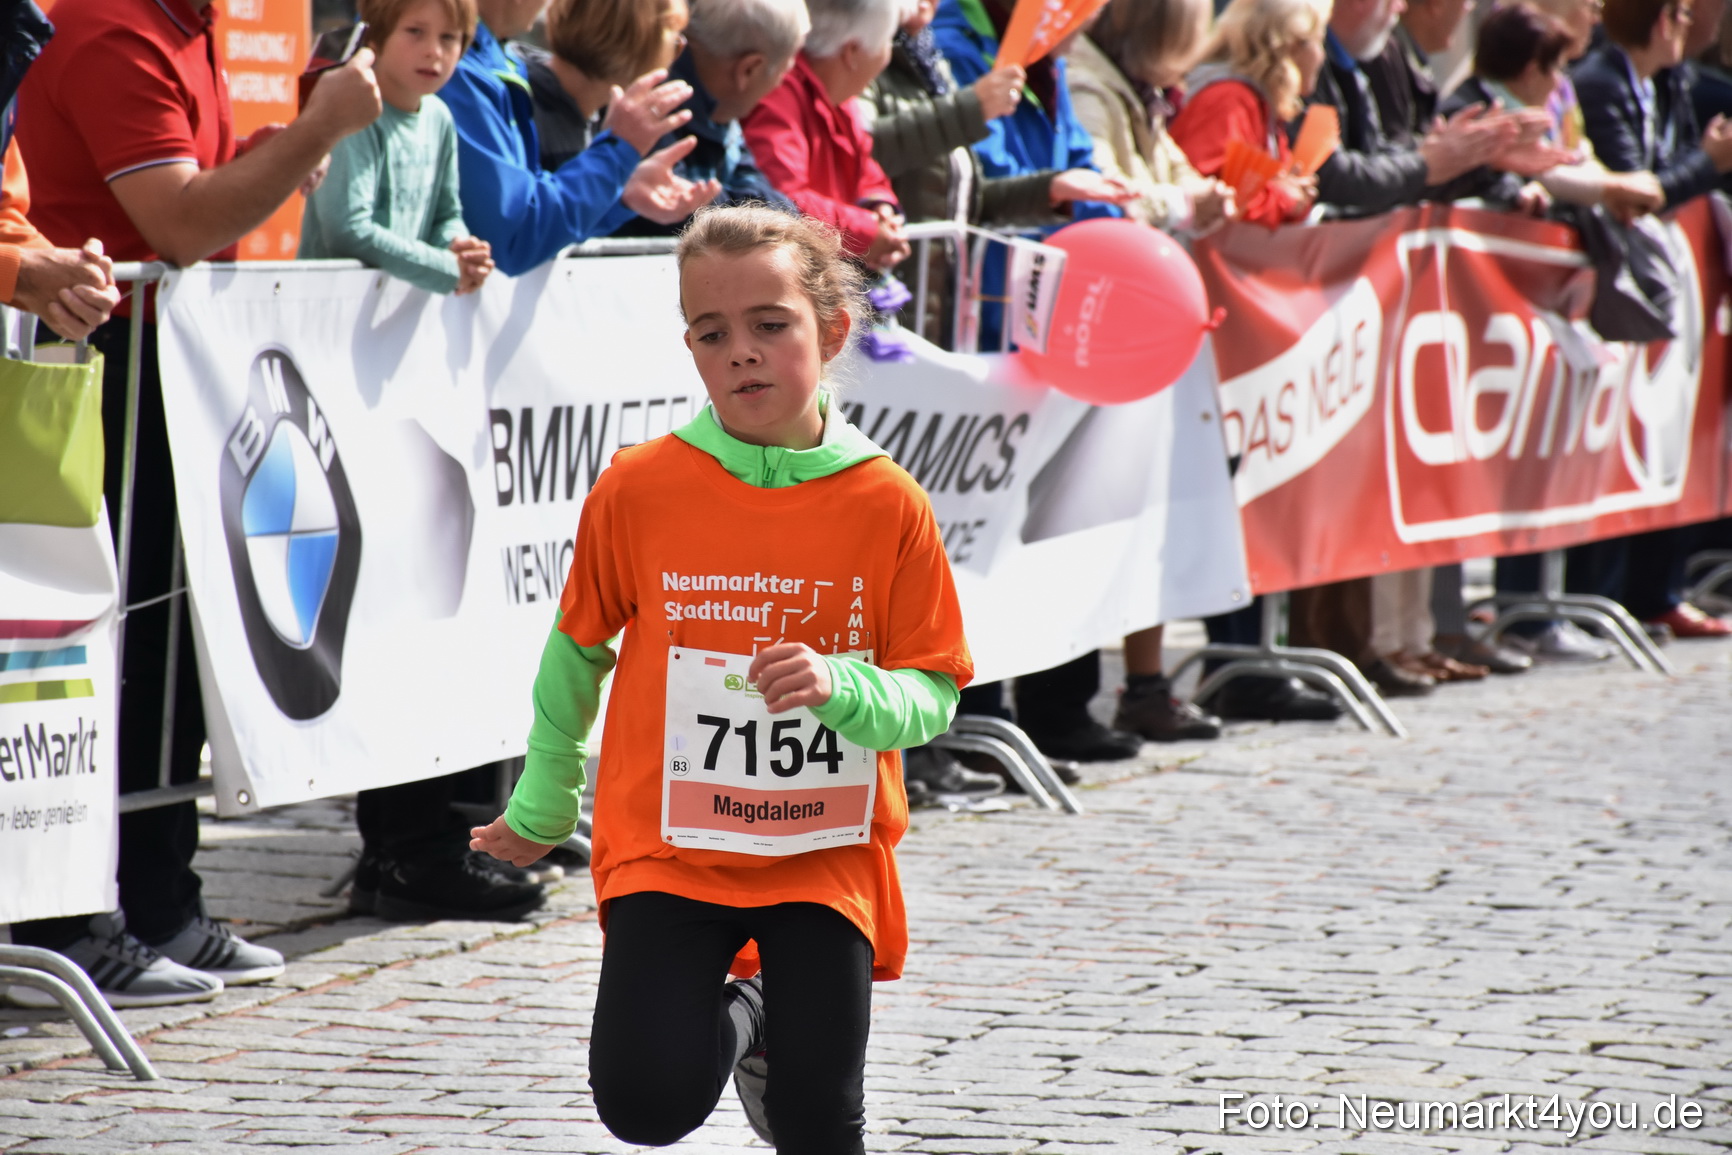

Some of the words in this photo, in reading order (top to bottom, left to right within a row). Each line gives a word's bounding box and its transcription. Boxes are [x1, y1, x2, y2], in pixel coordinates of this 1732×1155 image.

[1221, 381, 1297, 474] DAS
[1305, 320, 1366, 438] NEUE
[489, 403, 611, 507] BMW
[661, 571, 805, 595] Neumarkter
[664, 600, 774, 628] Stadtlauf
[847, 576, 864, 652] BAMB
[672, 760, 688, 772] B3
[697, 714, 844, 778] 7154
[713, 794, 825, 824] Magdalena
